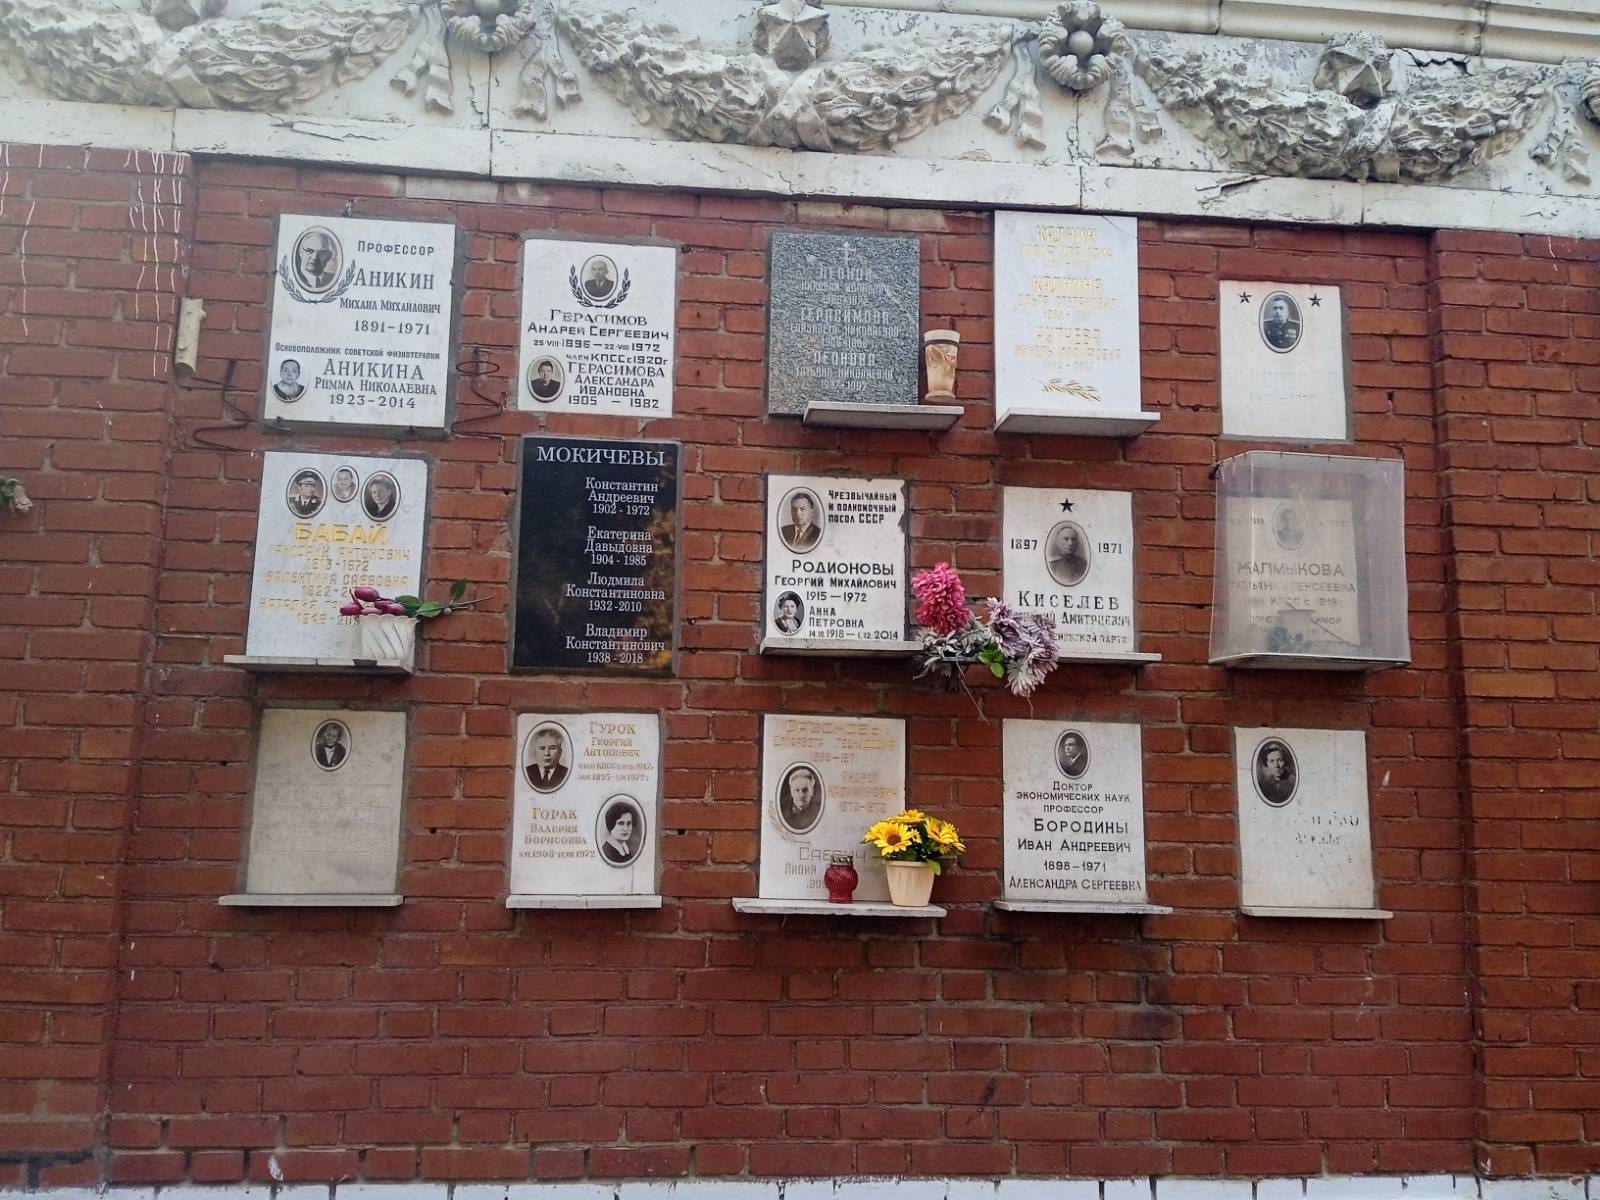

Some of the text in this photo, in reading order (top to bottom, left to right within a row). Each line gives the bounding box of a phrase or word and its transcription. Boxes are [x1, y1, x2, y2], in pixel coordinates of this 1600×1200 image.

[358, 241, 435, 256] ПРОФЕССОР
[353, 268, 435, 291] АНИКИН
[339, 298, 441, 314] МИХАИЛ МИХАЙЛОВИЧ
[550, 309, 648, 327] ГЕРАСИМОВ
[528, 322, 669, 340] АНДРЕЙ СЕРГЕЕВИЧ
[323, 359, 425, 381] АНИКИНА
[568, 362, 665, 378] ГЕРАСИМОВА
[315, 377, 438, 396] РИММА НИКОЛАЕВНА
[575, 375, 655, 388] АЛЕКСАНДРА
[580, 385, 645, 398] ИВАНОВНА
[569, 395, 597, 405] 1905
[630, 398, 659, 409] 1982
[537, 446, 666, 467] МОКИЧЕВЫ
[585, 477, 659, 492] Константин
[588, 490, 655, 506] Андреевич
[828, 490, 897, 502] ЧРЕЗВЫЧАЙНЫЙ
[828, 503, 897, 513] И ПОЛНОМОЧНЫЙ
[828, 514, 885, 525] ПОСОЛ СССР
[295, 522, 387, 544] БАБАЙ
[588, 526, 652, 543] Екатерина
[584, 539, 654, 554] Давыдовна
[1011, 538, 1038, 551] 1897
[1098, 542, 1123, 555] 1971
[792, 559, 894, 576] РОДИОНОВЫ
[587, 572, 645, 587] Людмила
[775, 575, 897, 589] ГЕОРГИЙ МИХАЙЛОВИЧ
[566, 584, 666, 600] Константиновна
[1019, 591, 1120, 611] КИСЕЛЕВ
[809, 606, 837, 617] АННА
[809, 619, 865, 628] ПЕТРОВНА
[585, 623, 648, 641] Владимир
[565, 636, 665, 651] Константинович
[1053, 781, 1093, 792] ДОКТОР
[1016, 792, 1130, 803] ЭКОНОМИЧЕСКИХ НАУК
[1043, 805, 1104, 815] ПРОФЕССОР
[1034, 818, 1129, 835] БОРОДИНЫ
[1018, 838, 1131, 854] ИВАН АНДРЕЕВИЧ
[1009, 876, 1142, 892] АЛЕКСАНДРА СЕРГЕЕВНА
